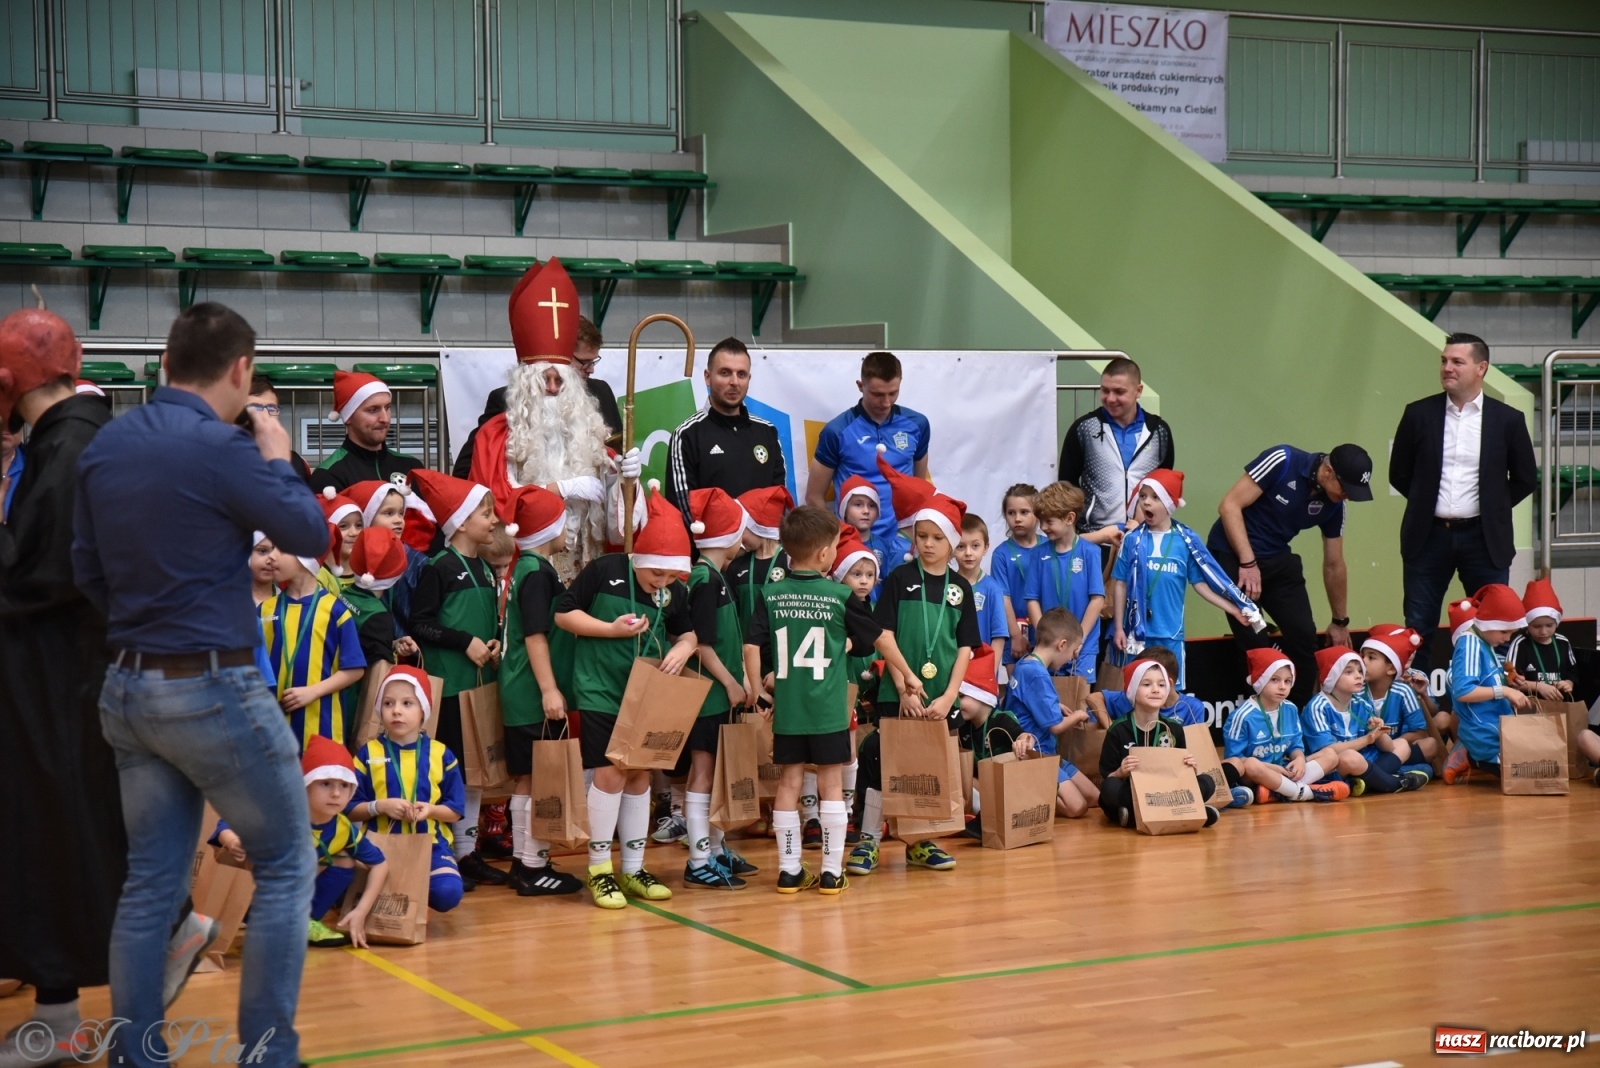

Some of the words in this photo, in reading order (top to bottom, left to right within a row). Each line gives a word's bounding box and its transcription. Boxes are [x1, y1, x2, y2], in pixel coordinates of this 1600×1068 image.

[1066, 12, 1207, 51] MIESZKO
[1084, 68, 1110, 78] rator
[1112, 70, 1157, 81] urządzeń
[1159, 72, 1224, 85] cukierniczych
[1121, 83, 1180, 96] produkcyjny
[1170, 105, 1182, 114] na
[1184, 105, 1217, 115] Ciebie!
[767, 593, 802, 602] AKADEMIA
[773, 608, 834, 621] TWORKÓW
[774, 625, 832, 680] 14
